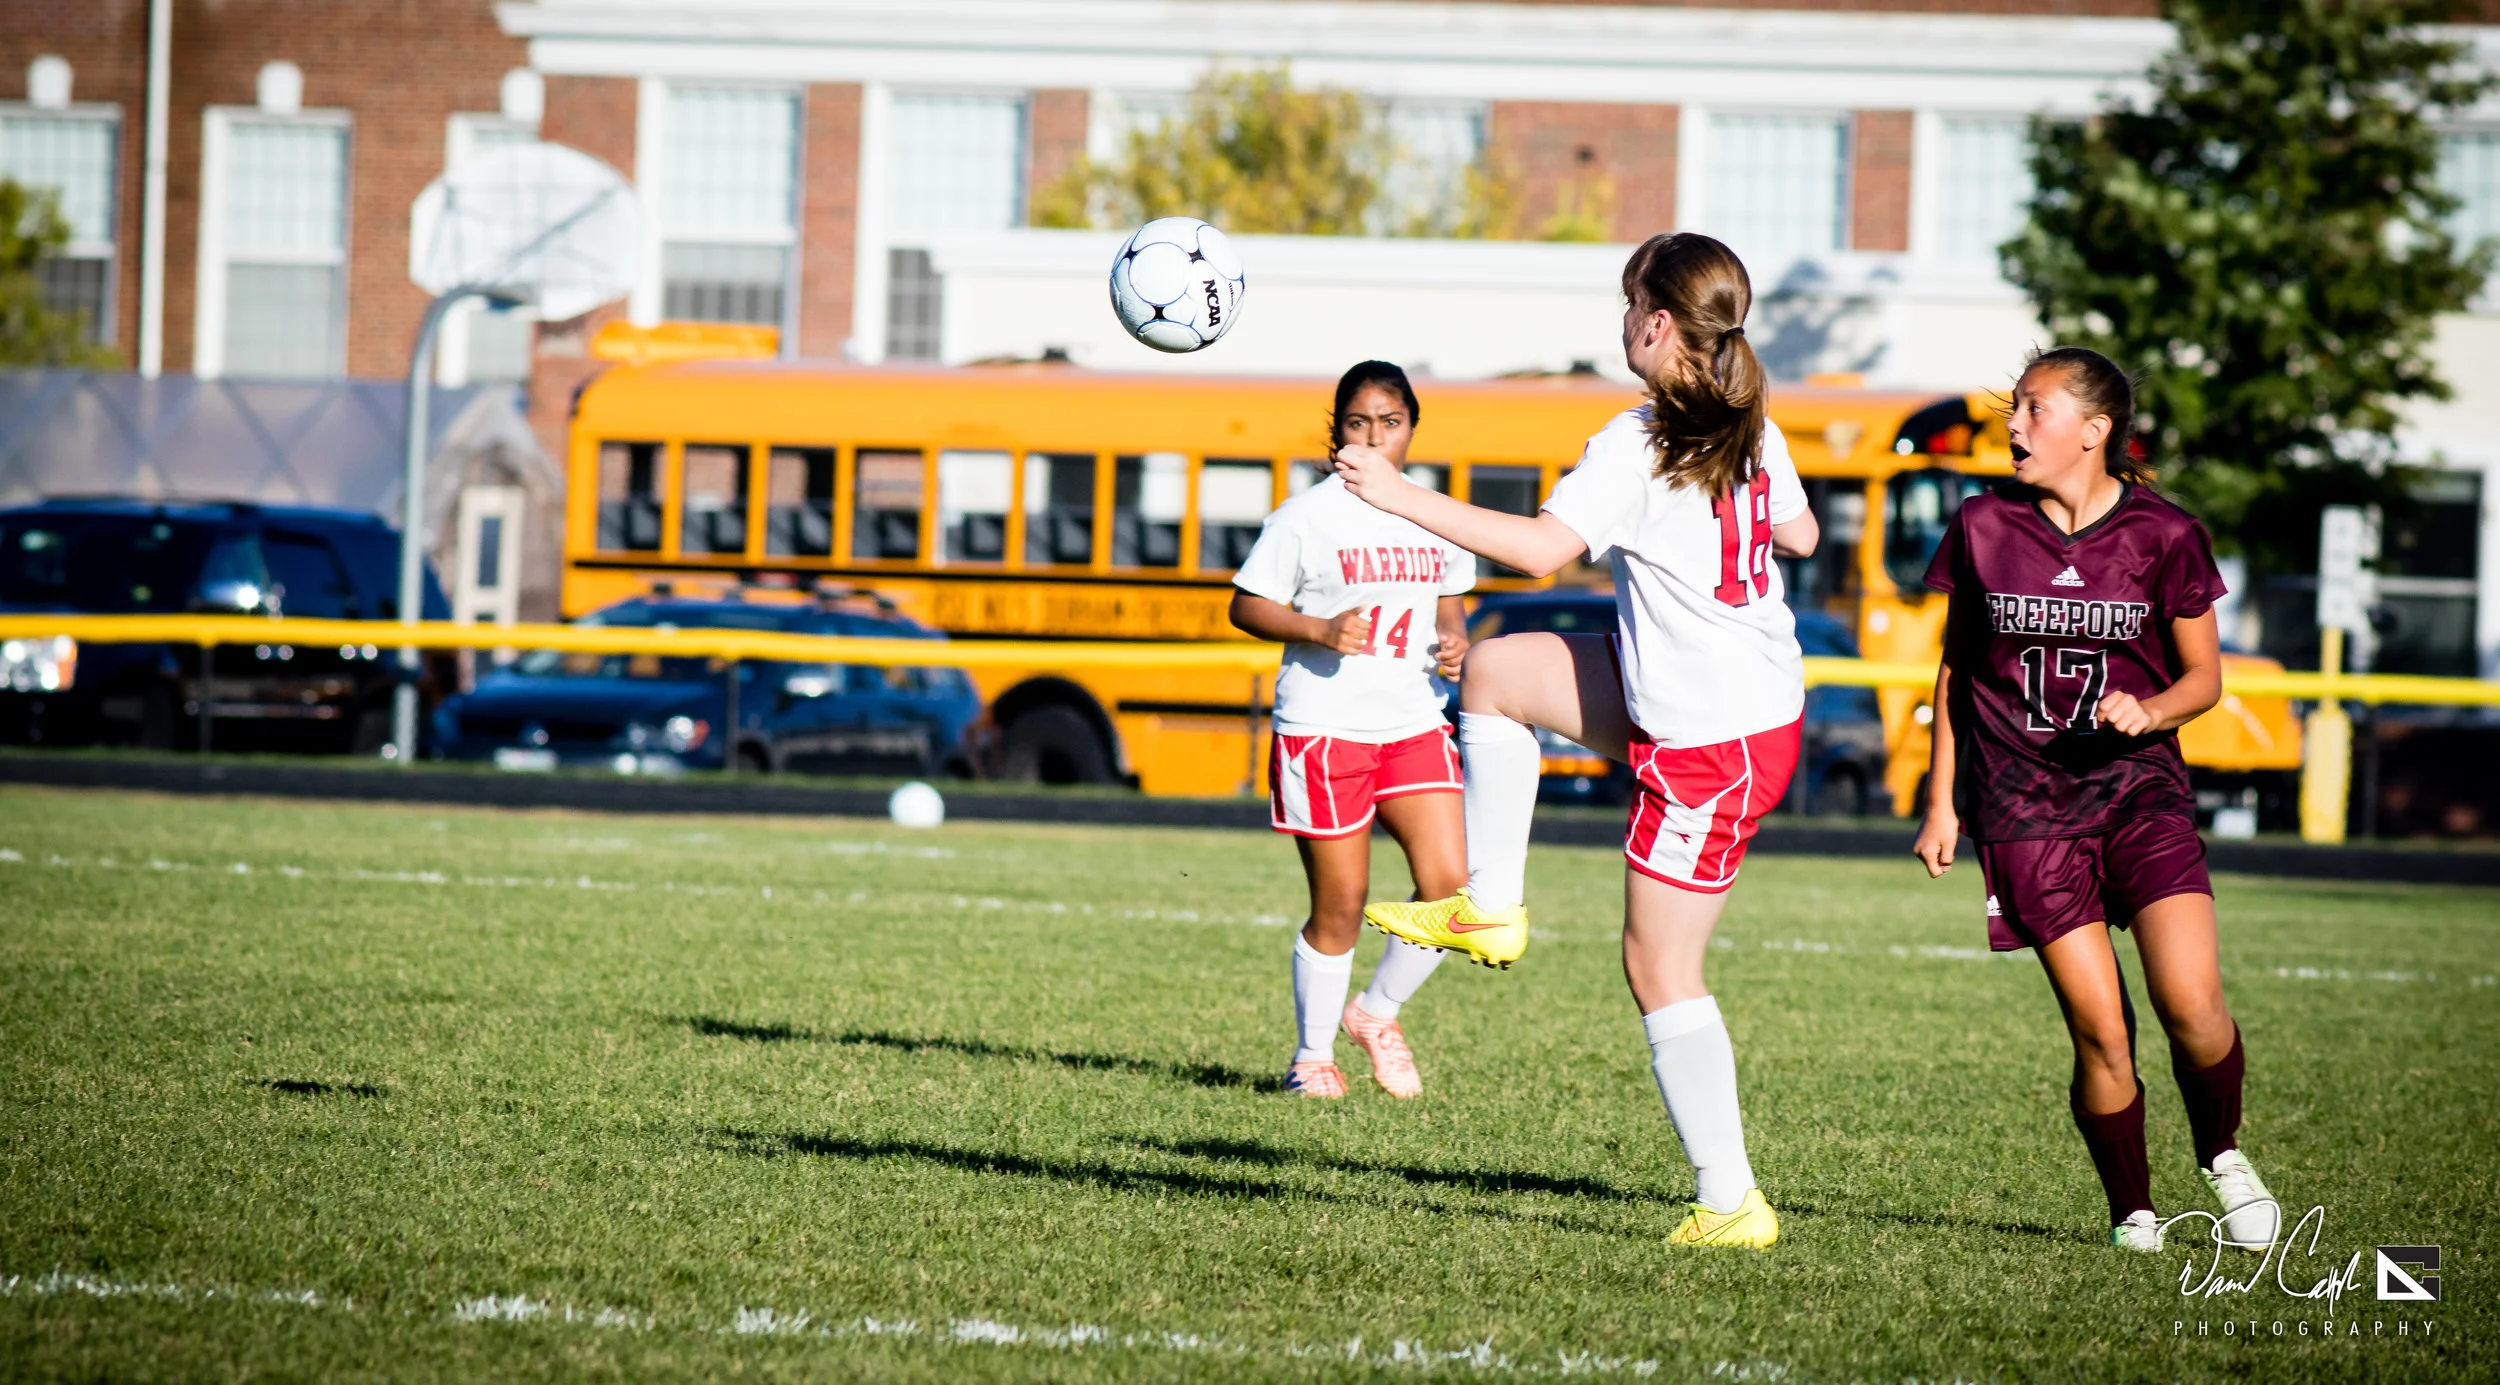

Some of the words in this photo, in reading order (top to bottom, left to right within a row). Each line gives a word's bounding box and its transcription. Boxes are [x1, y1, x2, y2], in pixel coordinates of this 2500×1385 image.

[1203, 279, 1221, 328] NCAA
[1710, 467, 1772, 608] 18
[1337, 547, 1449, 585] WARRIOR
[2051, 578, 2085, 587] adidas
[1360, 605, 1413, 659] 14
[1985, 592, 2150, 641] FREEPORT
[2020, 646, 2108, 736] 17
